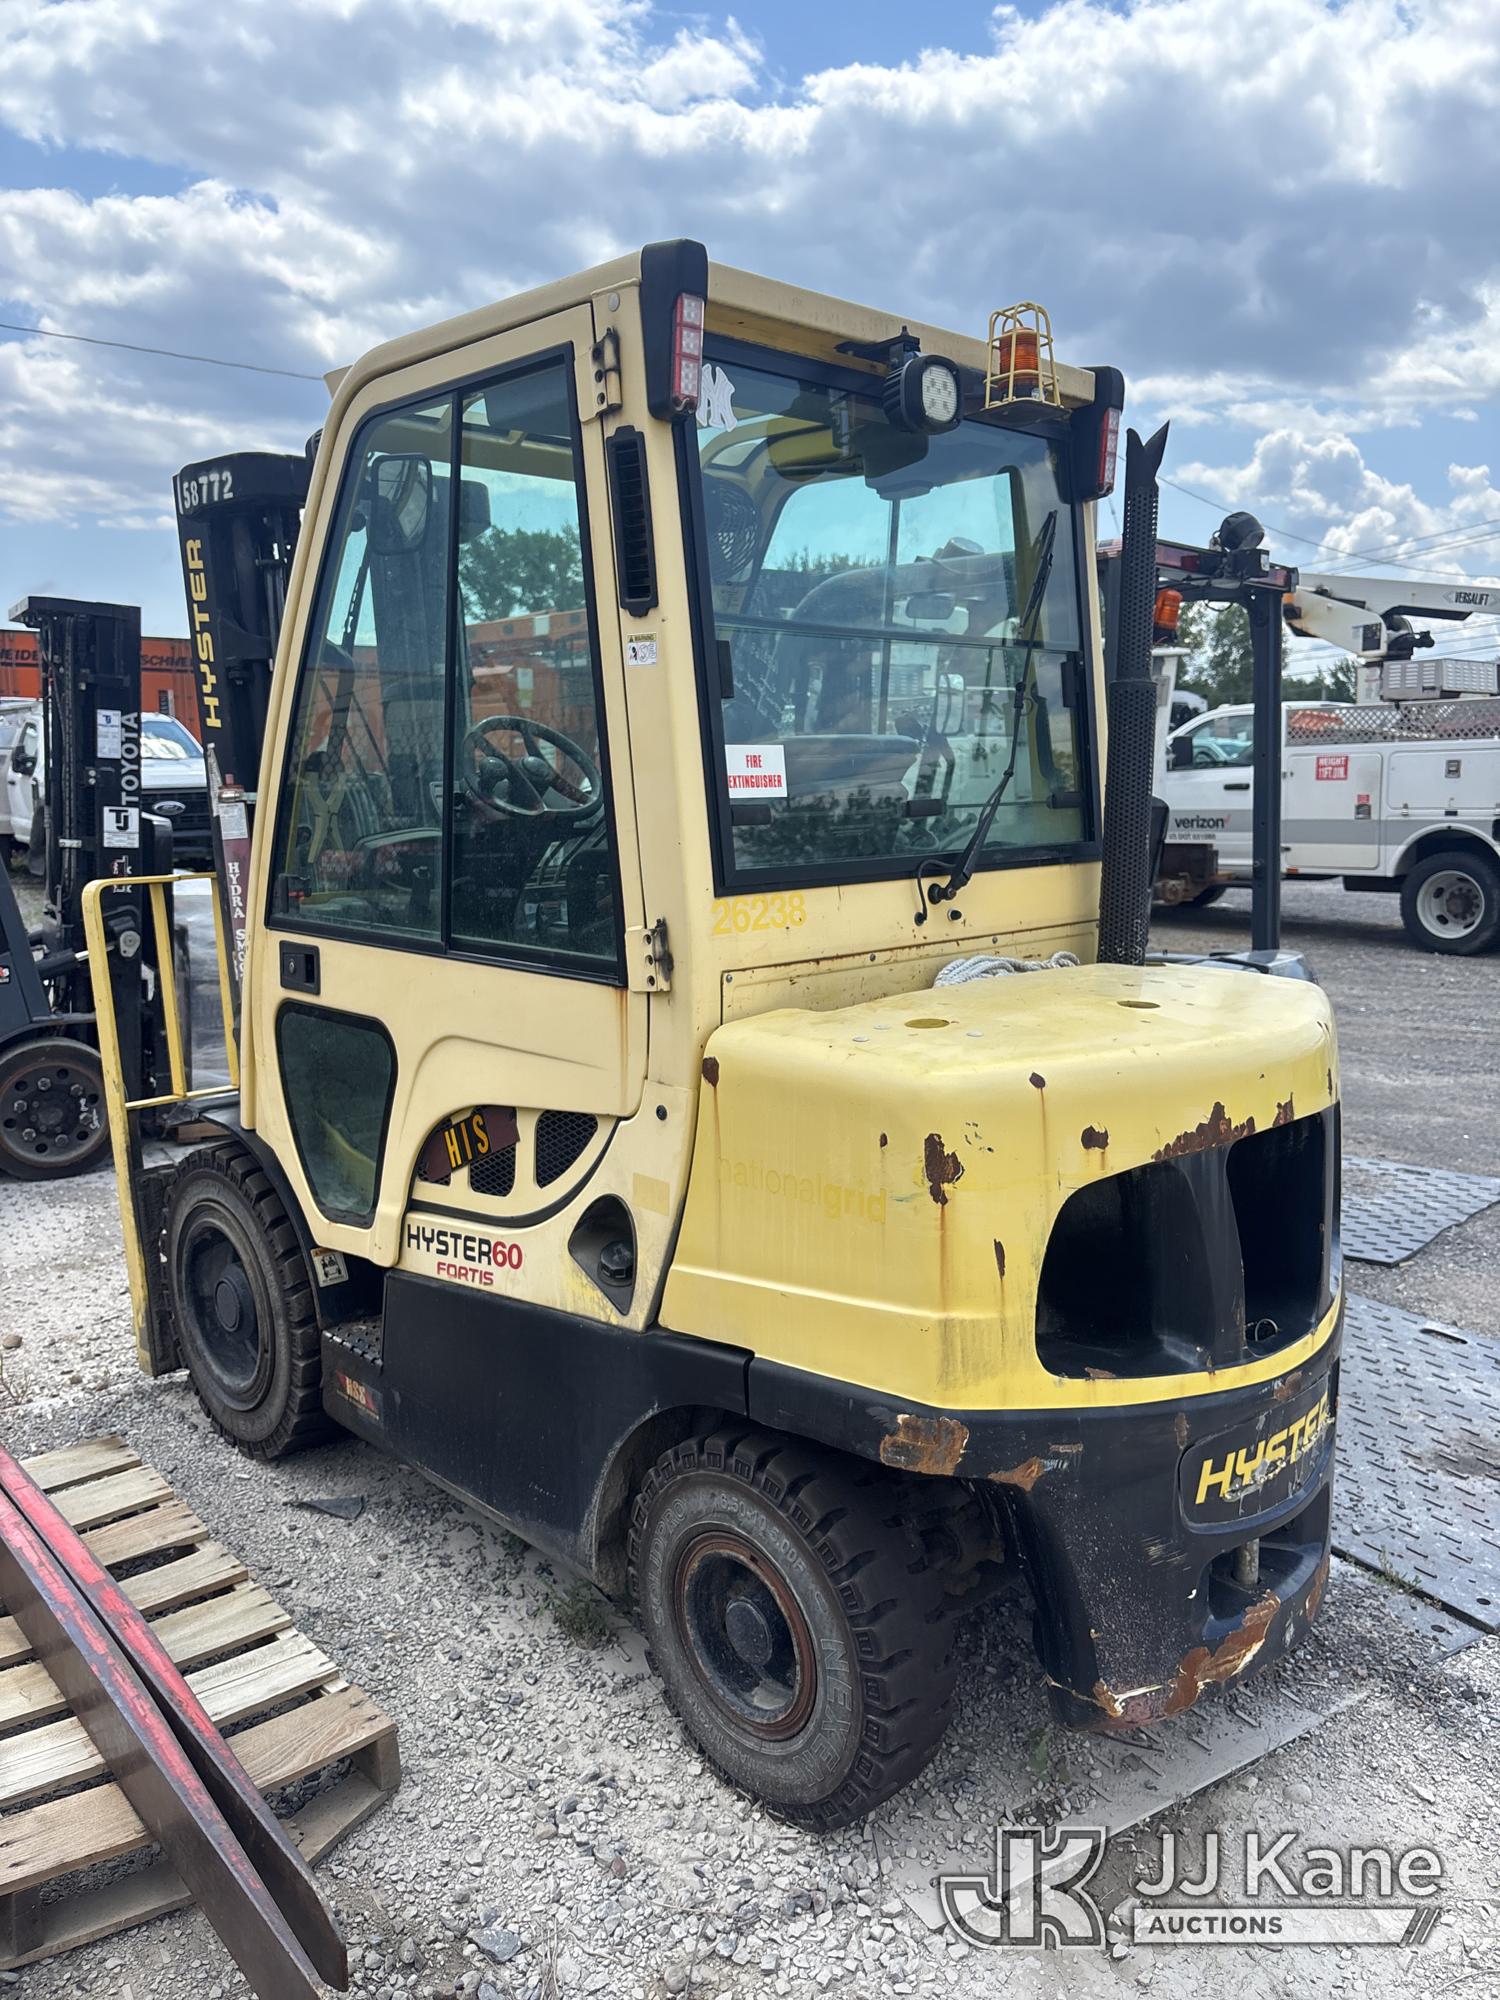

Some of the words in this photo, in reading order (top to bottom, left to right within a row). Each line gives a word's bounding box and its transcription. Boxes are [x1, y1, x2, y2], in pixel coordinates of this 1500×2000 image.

[182, 471, 234, 509] 58772
[1455, 591, 1490, 606] VERSALIFT
[186, 538, 222, 728] HYSTER
[120, 711, 139, 805] TOYOTA
[745, 754, 762, 769] FIRE
[728, 774, 783, 789] EXTINGUISHER
[1174, 814, 1225, 829] verizon
[227, 862, 246, 919] HYDRA
[711, 894, 808, 936] 26238
[717, 1154, 887, 1225] nationalgrid
[437, 1261, 494, 1286] FORTIS
